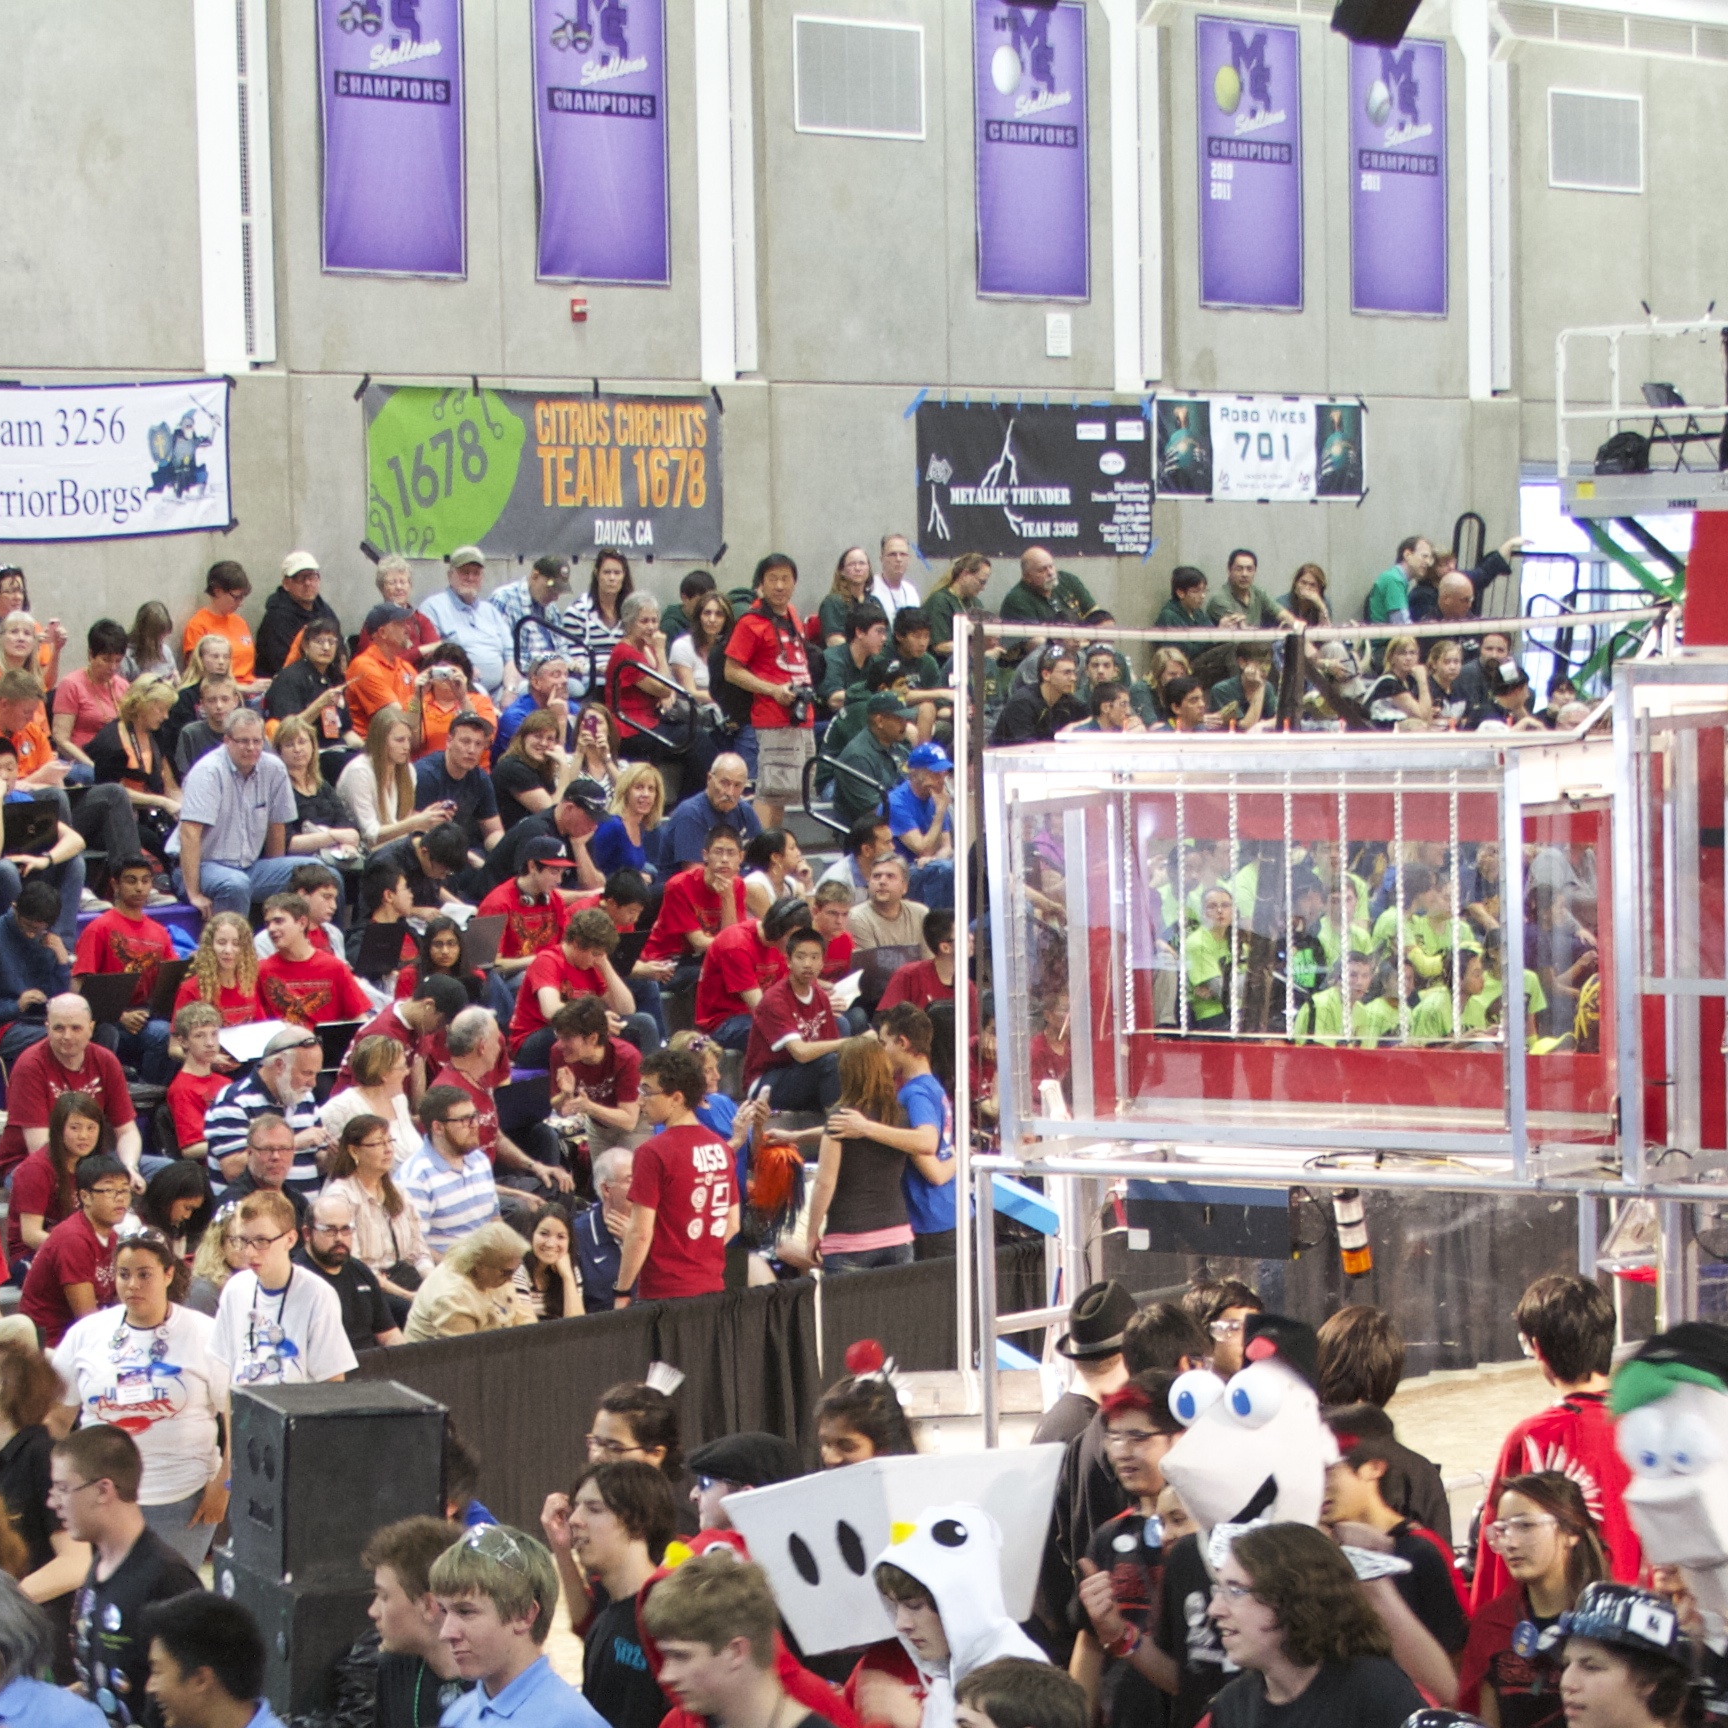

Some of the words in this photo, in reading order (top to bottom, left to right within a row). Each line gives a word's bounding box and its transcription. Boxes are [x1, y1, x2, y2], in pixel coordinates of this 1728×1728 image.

[337, 73, 447, 102] CHAMPIONS
[552, 90, 653, 117] CHAMPIONS
[988, 124, 1076, 147] CHAMPIONS
[1210, 140, 1291, 163] CHAMPIONS
[1360, 151, 1437, 175] CHAMPIONS
[1210, 162, 1234, 181] 2010
[1360, 173, 1382, 192] 2011
[1210, 181, 1233, 200] 2011
[55, 405, 126, 447] 3256
[534, 400, 610, 446] CITRUS
[614, 402, 708, 449] CIRCUITS
[1234, 431, 1291, 462] 701
[386, 419, 489, 519] 1678
[536, 446, 623, 508] TEAM
[632, 447, 706, 509] 1678
[949, 486, 1009, 506] METALLIC
[1010, 486, 1071, 506] THUNDER
[594, 518, 633, 548] DAVIS,
[635, 519, 654, 546] CA
[1021, 521, 1051, 538] TEAM
[1052, 521, 1079, 538] 3303
[692, 1143, 729, 1173] 4159
